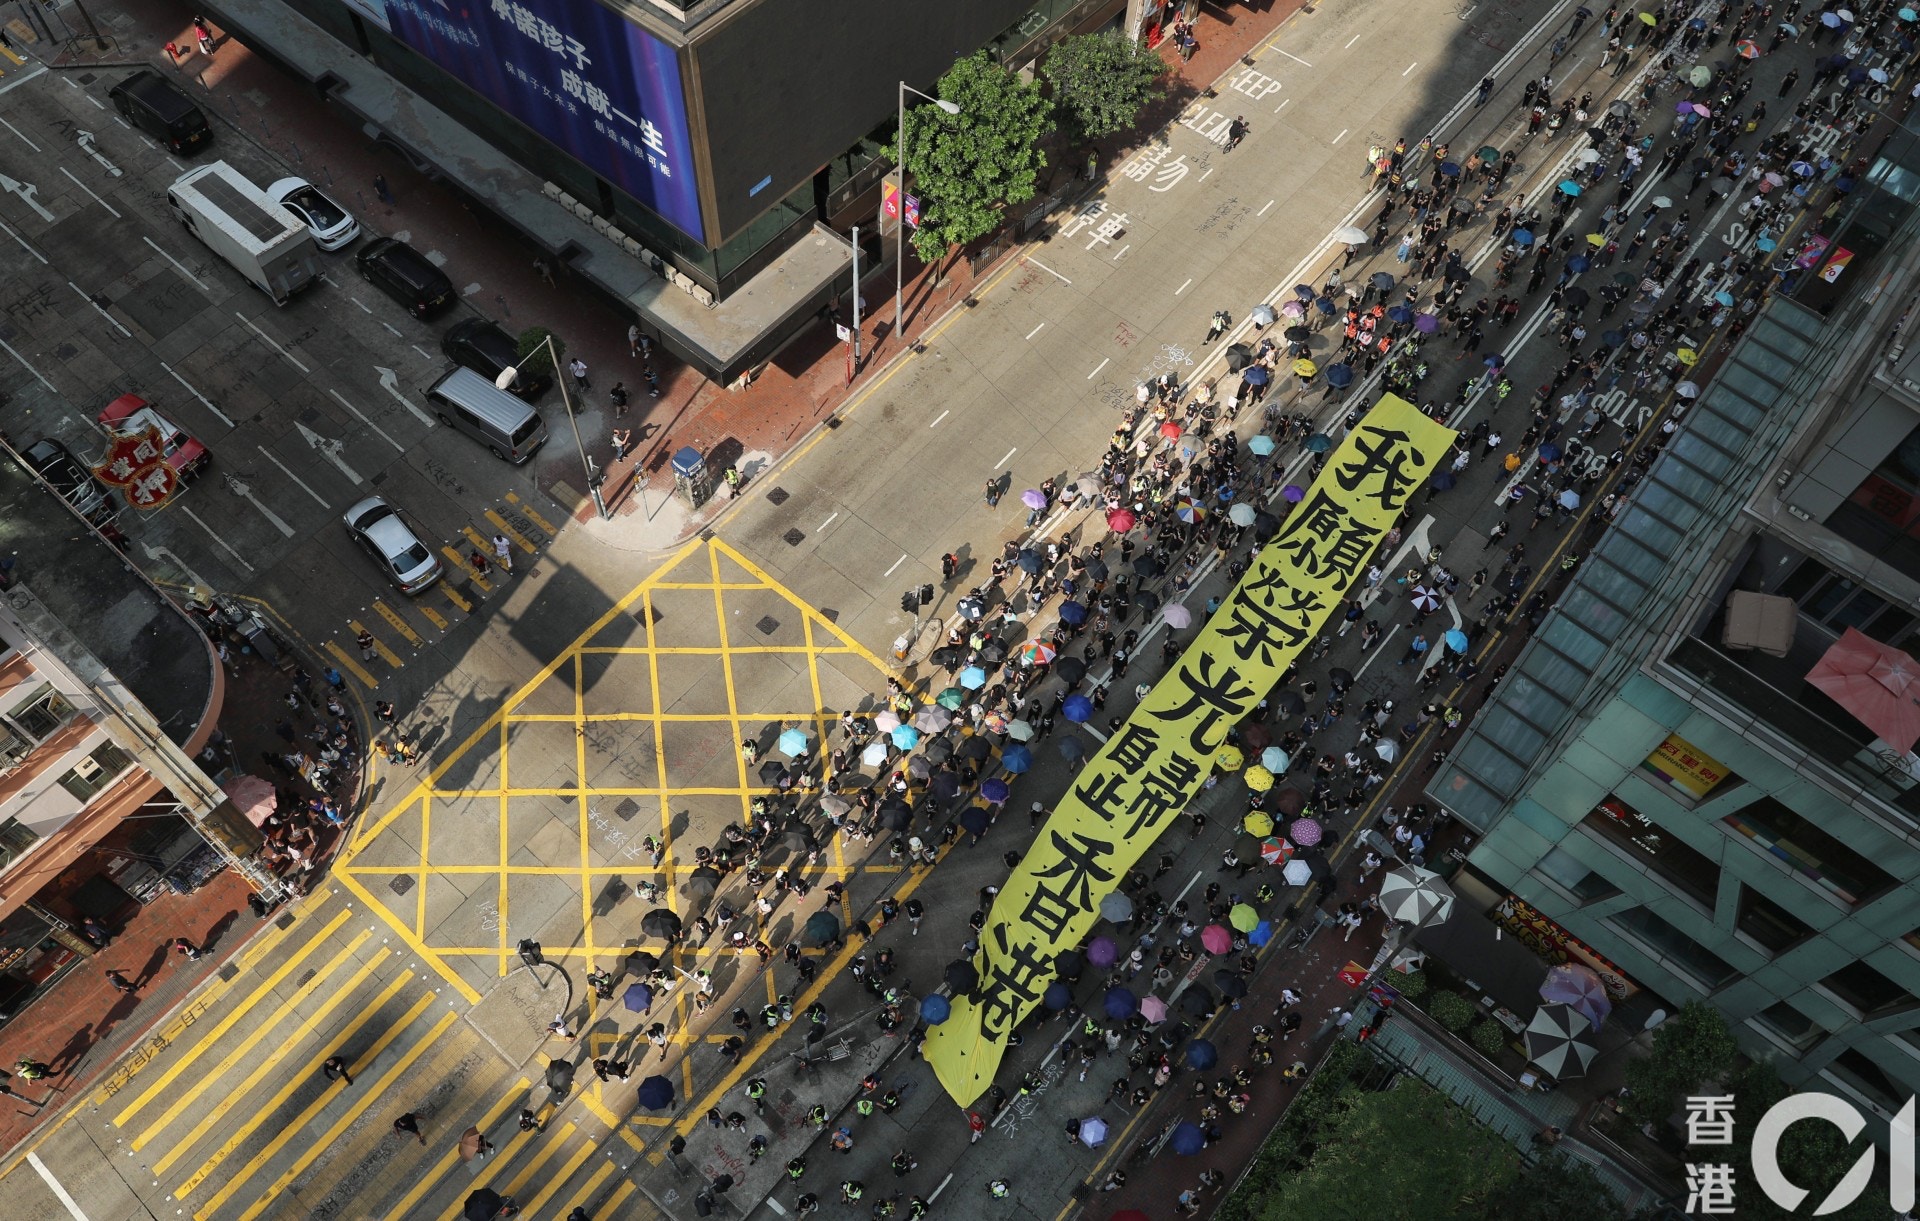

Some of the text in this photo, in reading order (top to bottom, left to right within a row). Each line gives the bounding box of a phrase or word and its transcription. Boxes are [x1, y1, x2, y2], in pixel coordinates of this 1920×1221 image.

[490, 0, 592, 72] 承諾孩子
[504, 61, 580, 116] 保障子女未來
[1229, 68, 1282, 101] KEEP
[560, 69, 668, 158] 成就一生
[594, 119, 672, 179] 創造無限可能
[1121, 142, 1190, 193] 請勿
[1058, 200, 1130, 250] 停車
[6, 281, 55, 316] FREE
[25, 295, 59, 321] HK
[979, 426, 1424, 1043] 我願榮光歸香港
[1660, 740, 1720, 783] 阿里朗
[103, 1001, 208, 1098] 十月一賀佢老母
